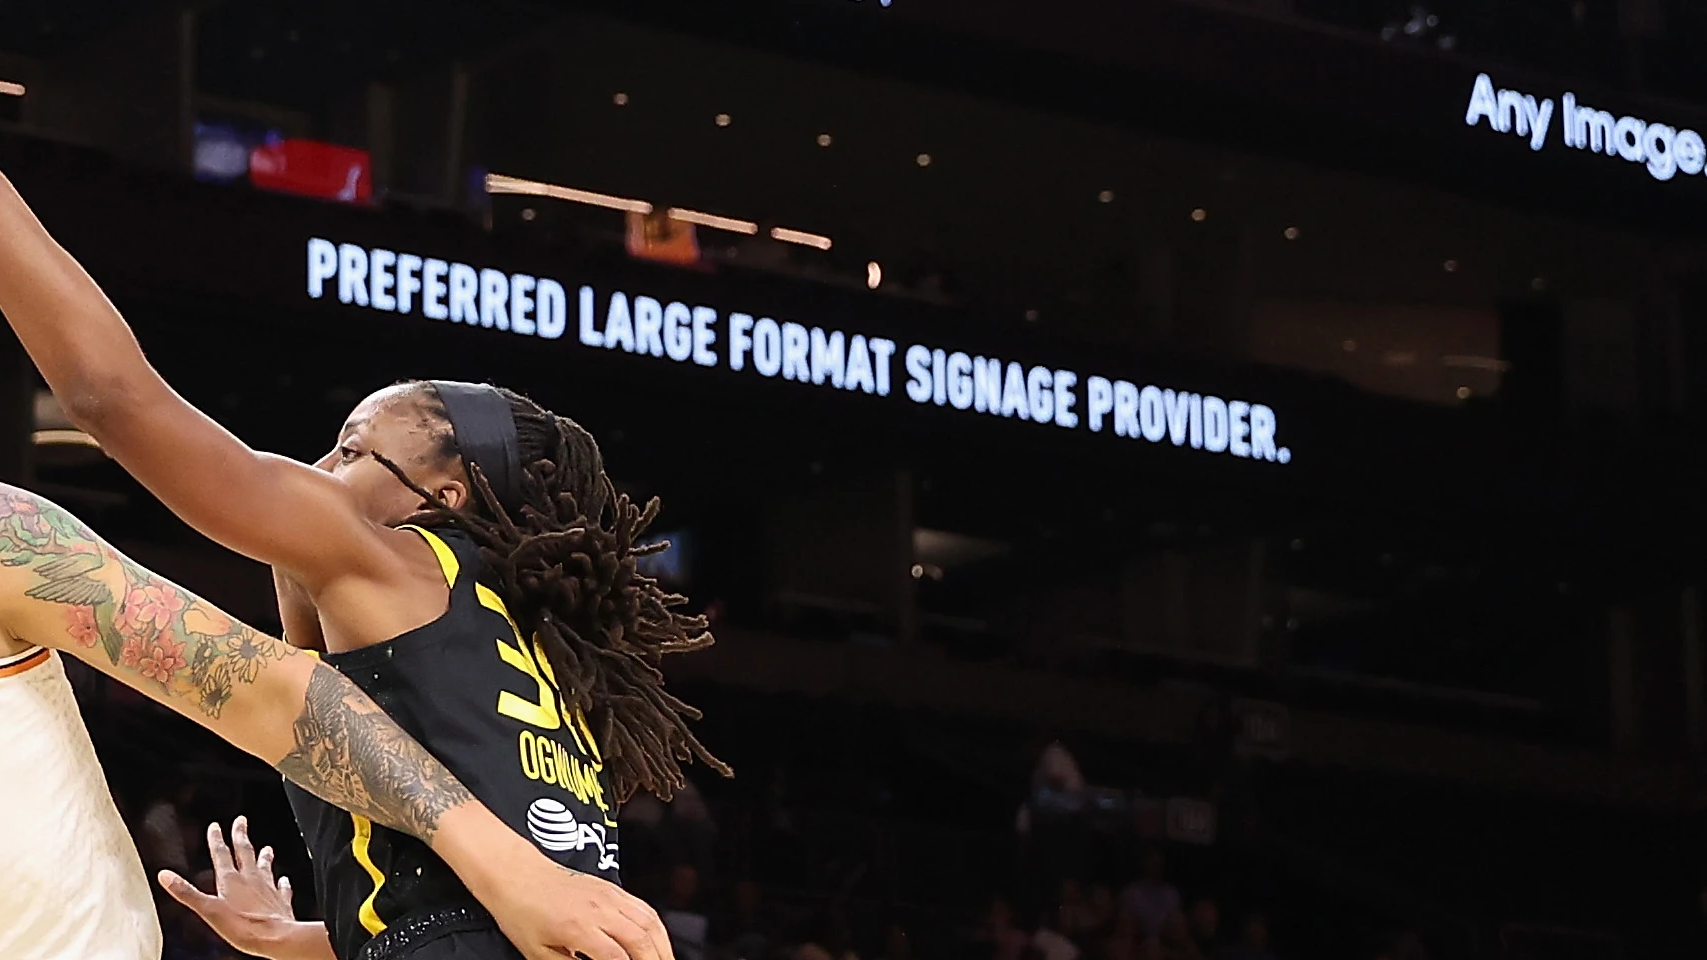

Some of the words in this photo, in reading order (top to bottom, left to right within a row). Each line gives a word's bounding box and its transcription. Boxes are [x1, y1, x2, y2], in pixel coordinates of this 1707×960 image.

[1465, 72, 1555, 151] Any
[306, 236, 567, 339] PREFERRED
[579, 285, 719, 367] LARGE
[729, 311, 896, 397] FORMAT
[906, 344, 1079, 428] SIGNAGE
[1087, 375, 1292, 465] PROVIDER.
